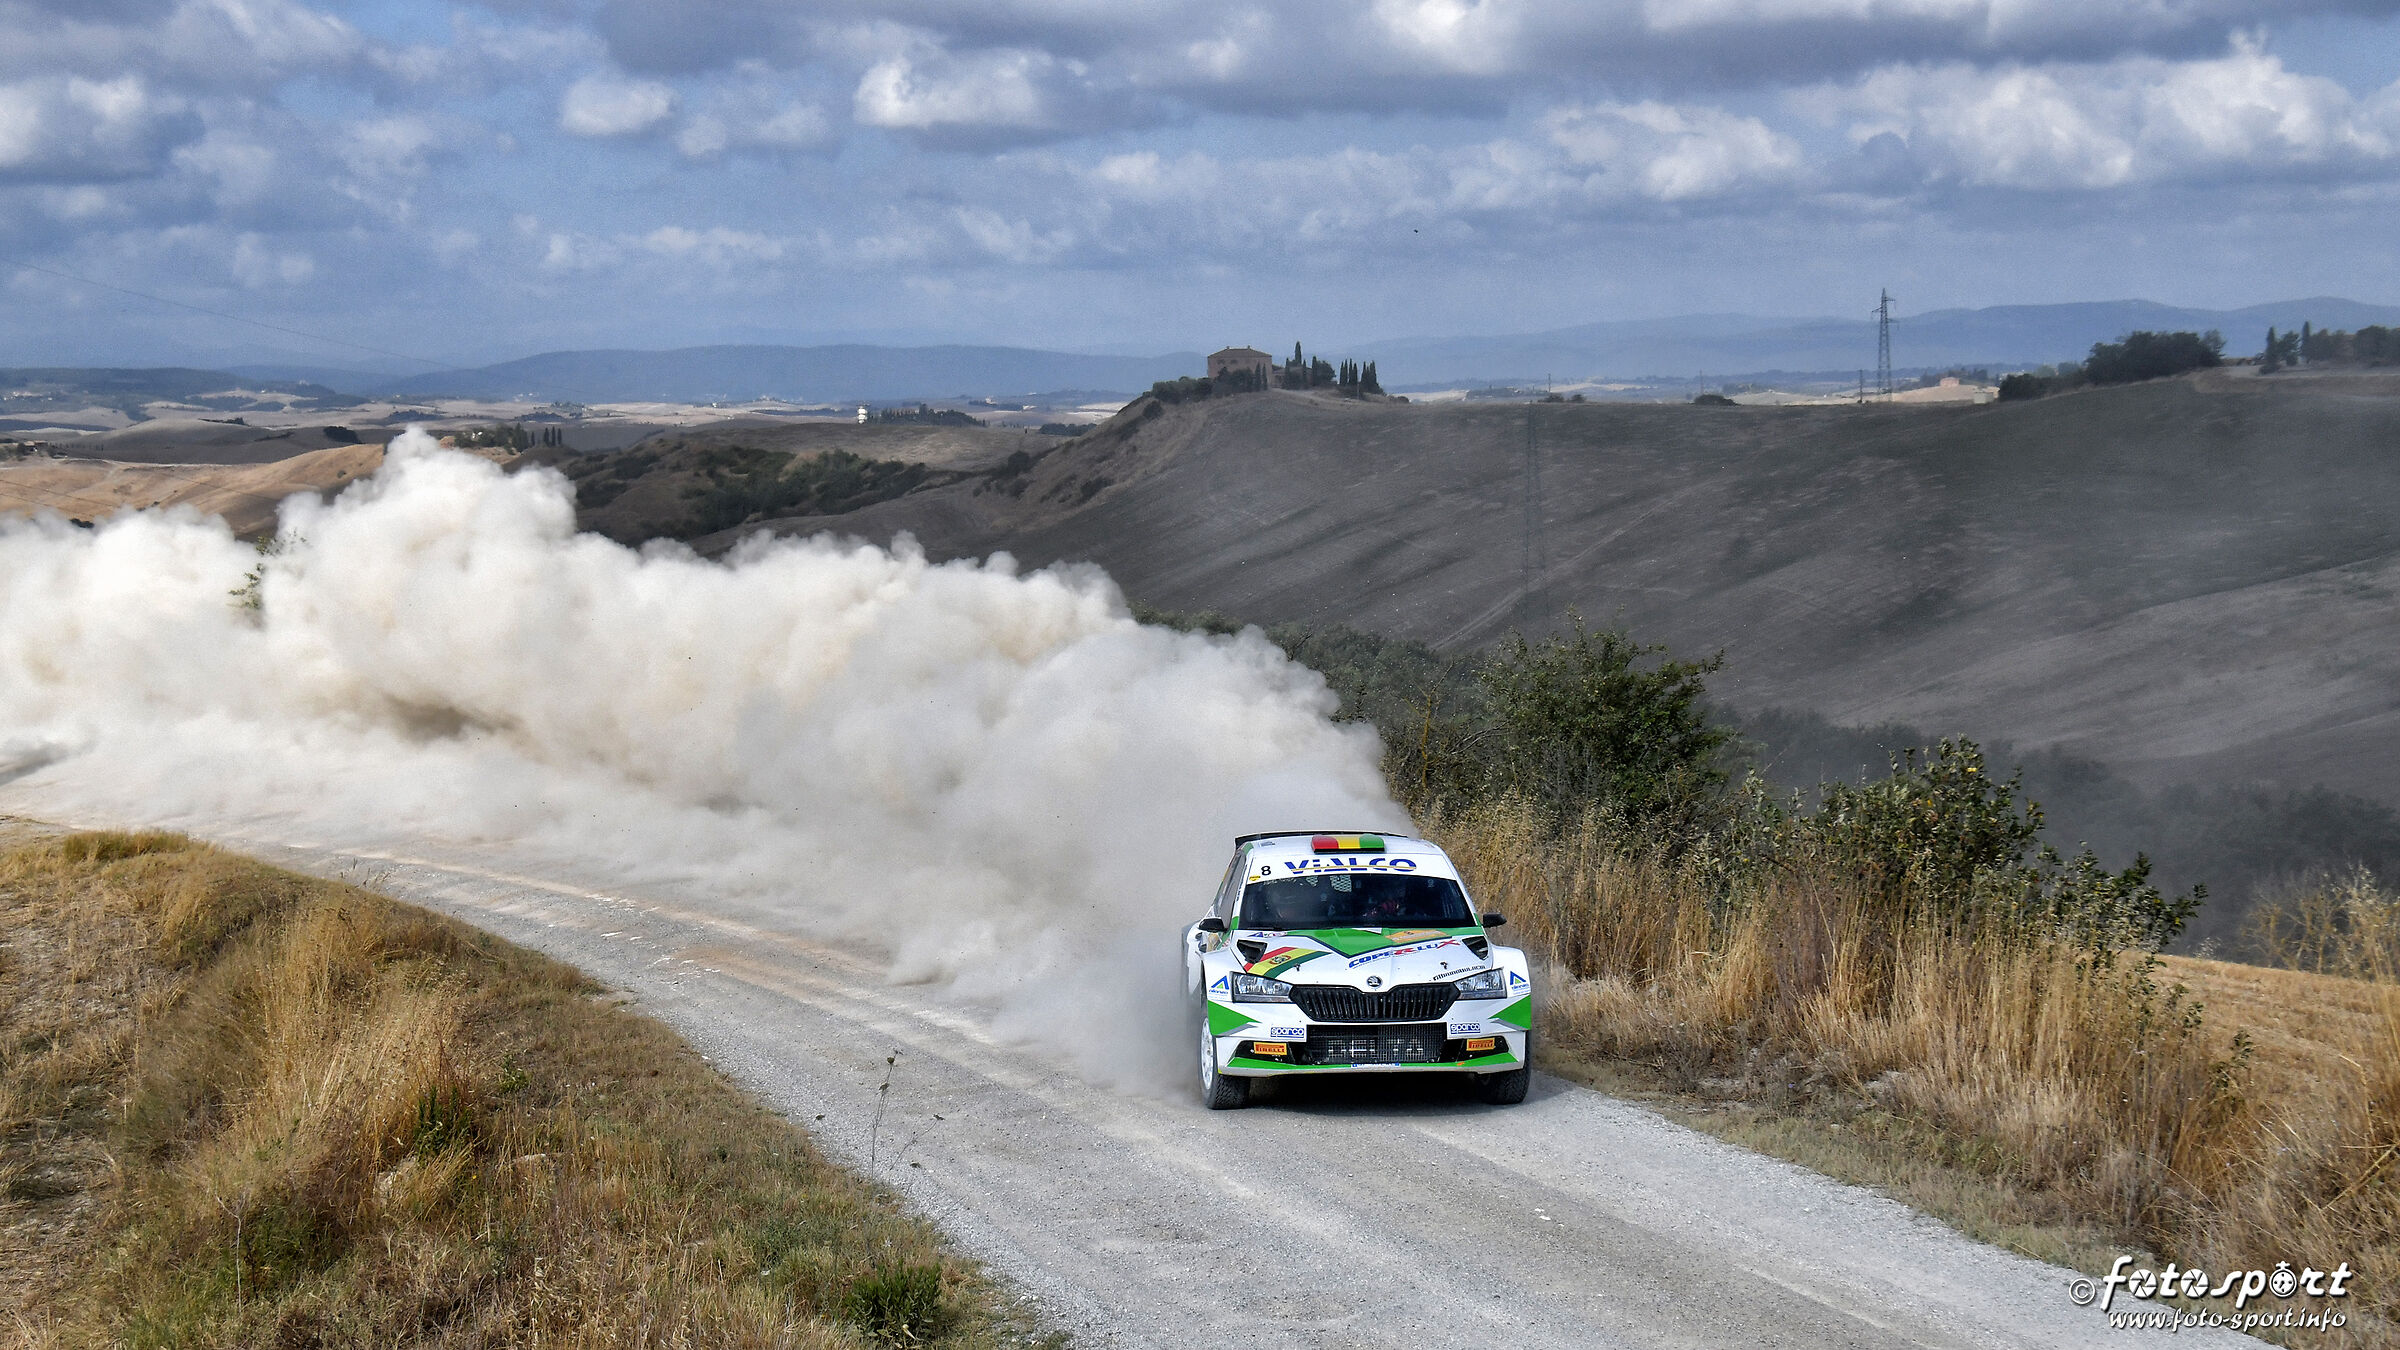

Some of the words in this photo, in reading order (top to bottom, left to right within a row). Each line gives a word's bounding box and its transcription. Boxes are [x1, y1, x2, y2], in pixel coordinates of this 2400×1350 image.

[1260, 865, 1272, 876] 8
[1270, 1027, 1304, 1038] sparco
[1450, 1023, 1480, 1034] sparco
[1255, 1043, 1285, 1053] PIRELLI
